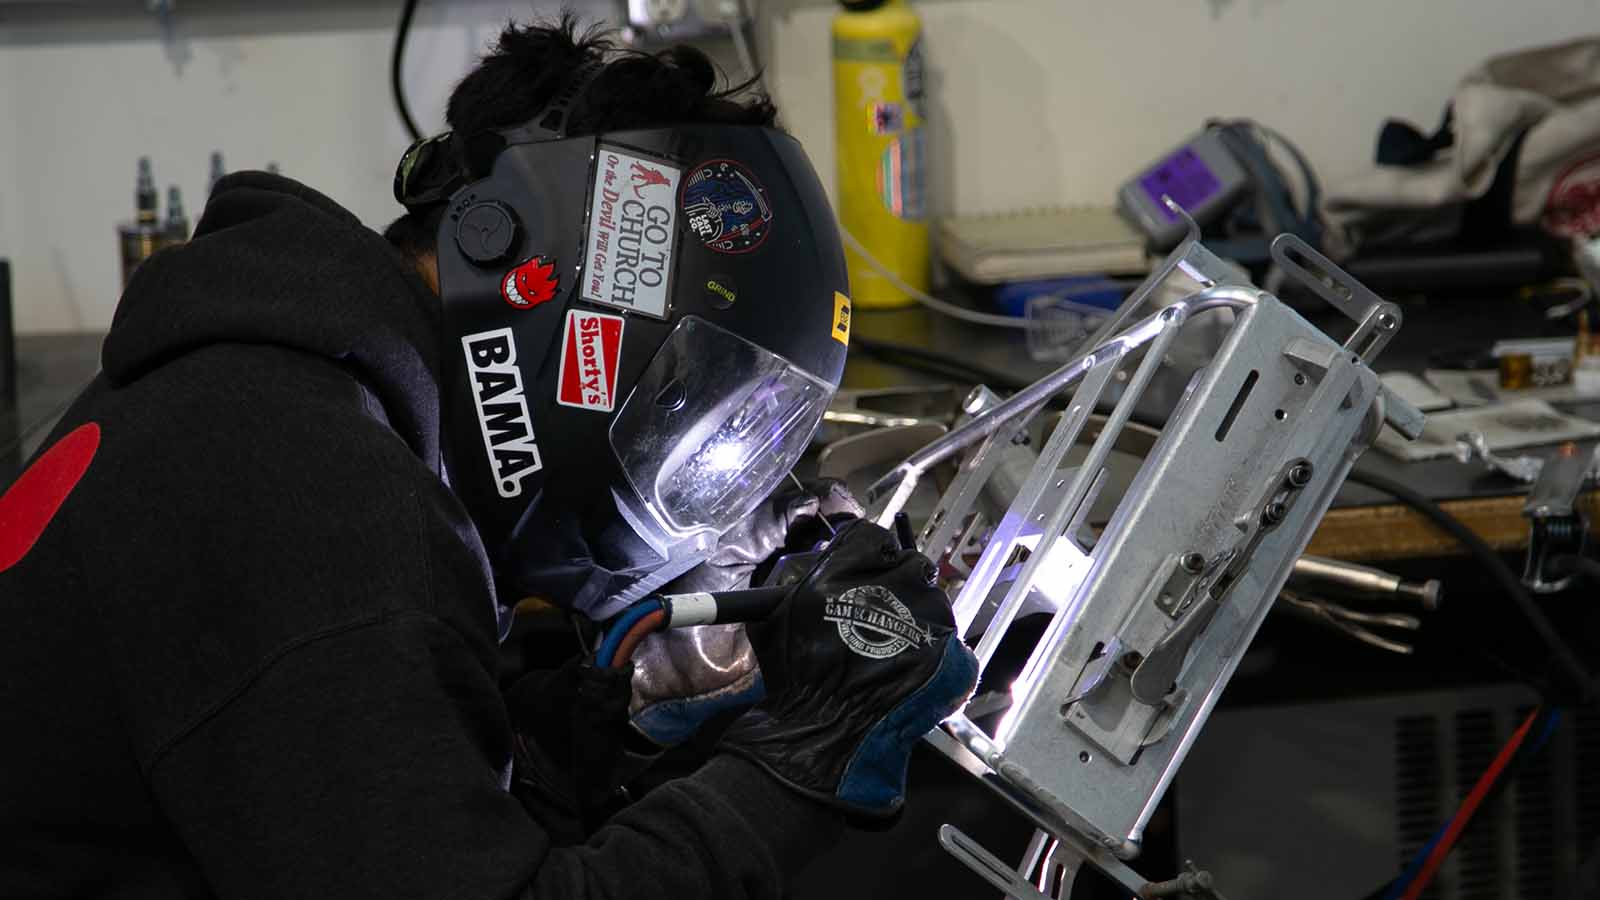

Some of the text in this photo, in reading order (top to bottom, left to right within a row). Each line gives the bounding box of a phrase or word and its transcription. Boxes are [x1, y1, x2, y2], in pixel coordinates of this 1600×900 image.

[606, 154, 619, 169] Or
[604, 169, 617, 187] the
[599, 188, 619, 231] Devil
[701, 214, 713, 233] LAST
[596, 230, 610, 255] Will
[611, 200, 646, 306] CHURCH
[639, 205, 671, 288] GO TO
[593, 254, 607, 271] Get
[707, 280, 736, 302] GRIND
[580, 317, 606, 404] Shorty's
[468, 335, 537, 493] BAMA.
